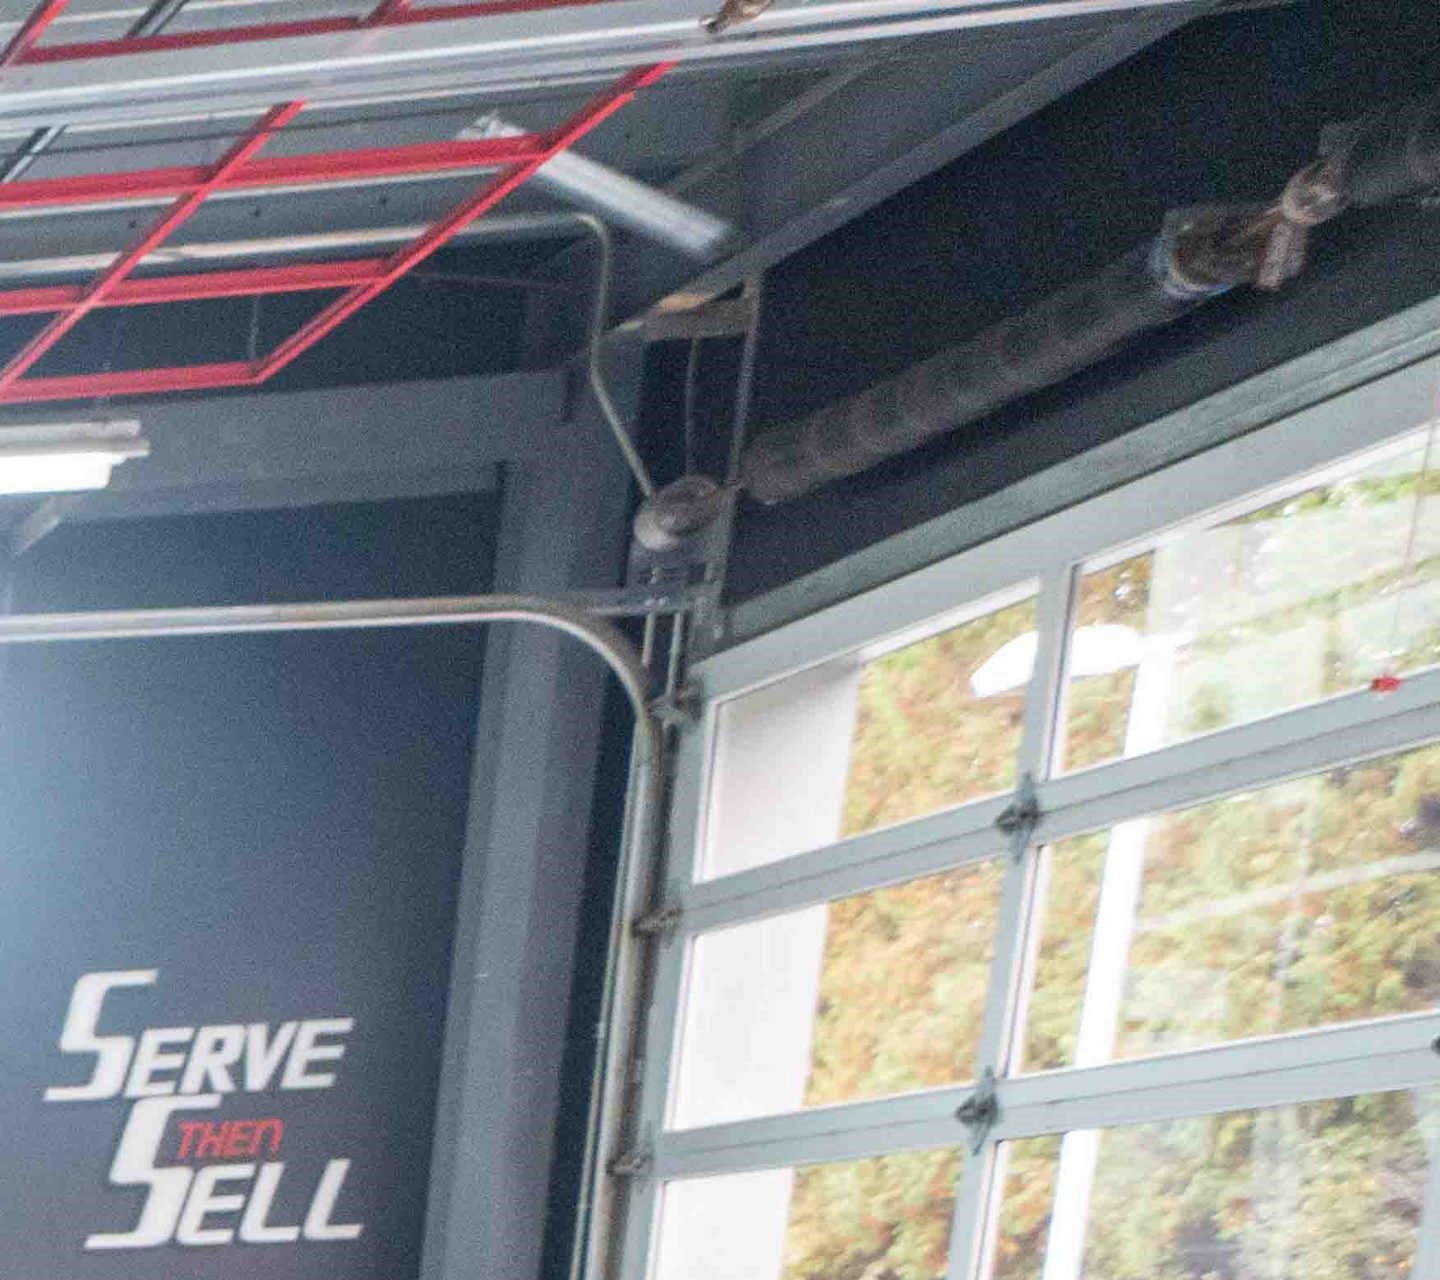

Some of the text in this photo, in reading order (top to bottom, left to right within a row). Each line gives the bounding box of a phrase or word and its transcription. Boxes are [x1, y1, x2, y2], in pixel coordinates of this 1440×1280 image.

[43, 968, 355, 1101] SERVE
[84, 1093, 364, 1250] SELL
[178, 1118, 284, 1158] THEN
